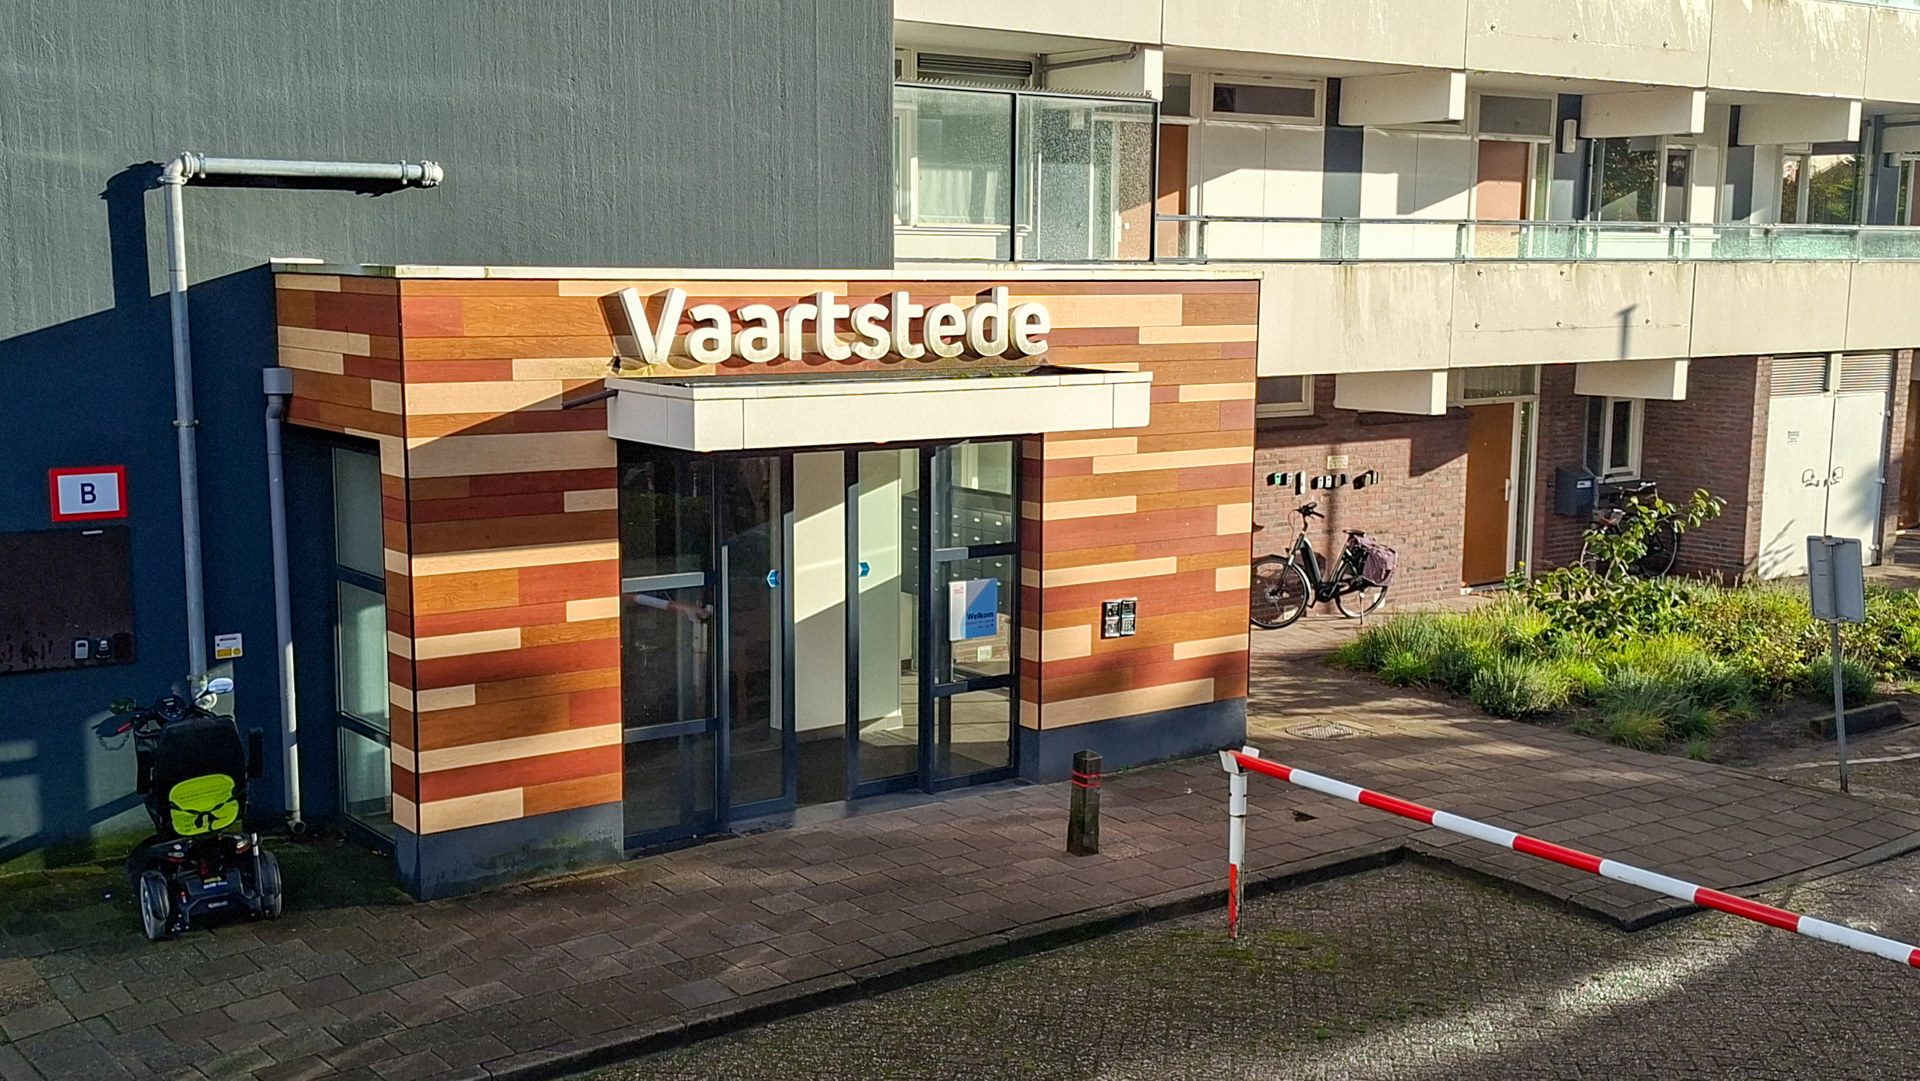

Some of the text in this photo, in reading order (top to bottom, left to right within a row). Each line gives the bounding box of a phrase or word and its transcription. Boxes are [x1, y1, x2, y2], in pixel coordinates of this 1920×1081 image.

[618, 286, 1051, 364] Vaartstede
[81, 482, 97, 504] B
[967, 612, 994, 620] Welkom
